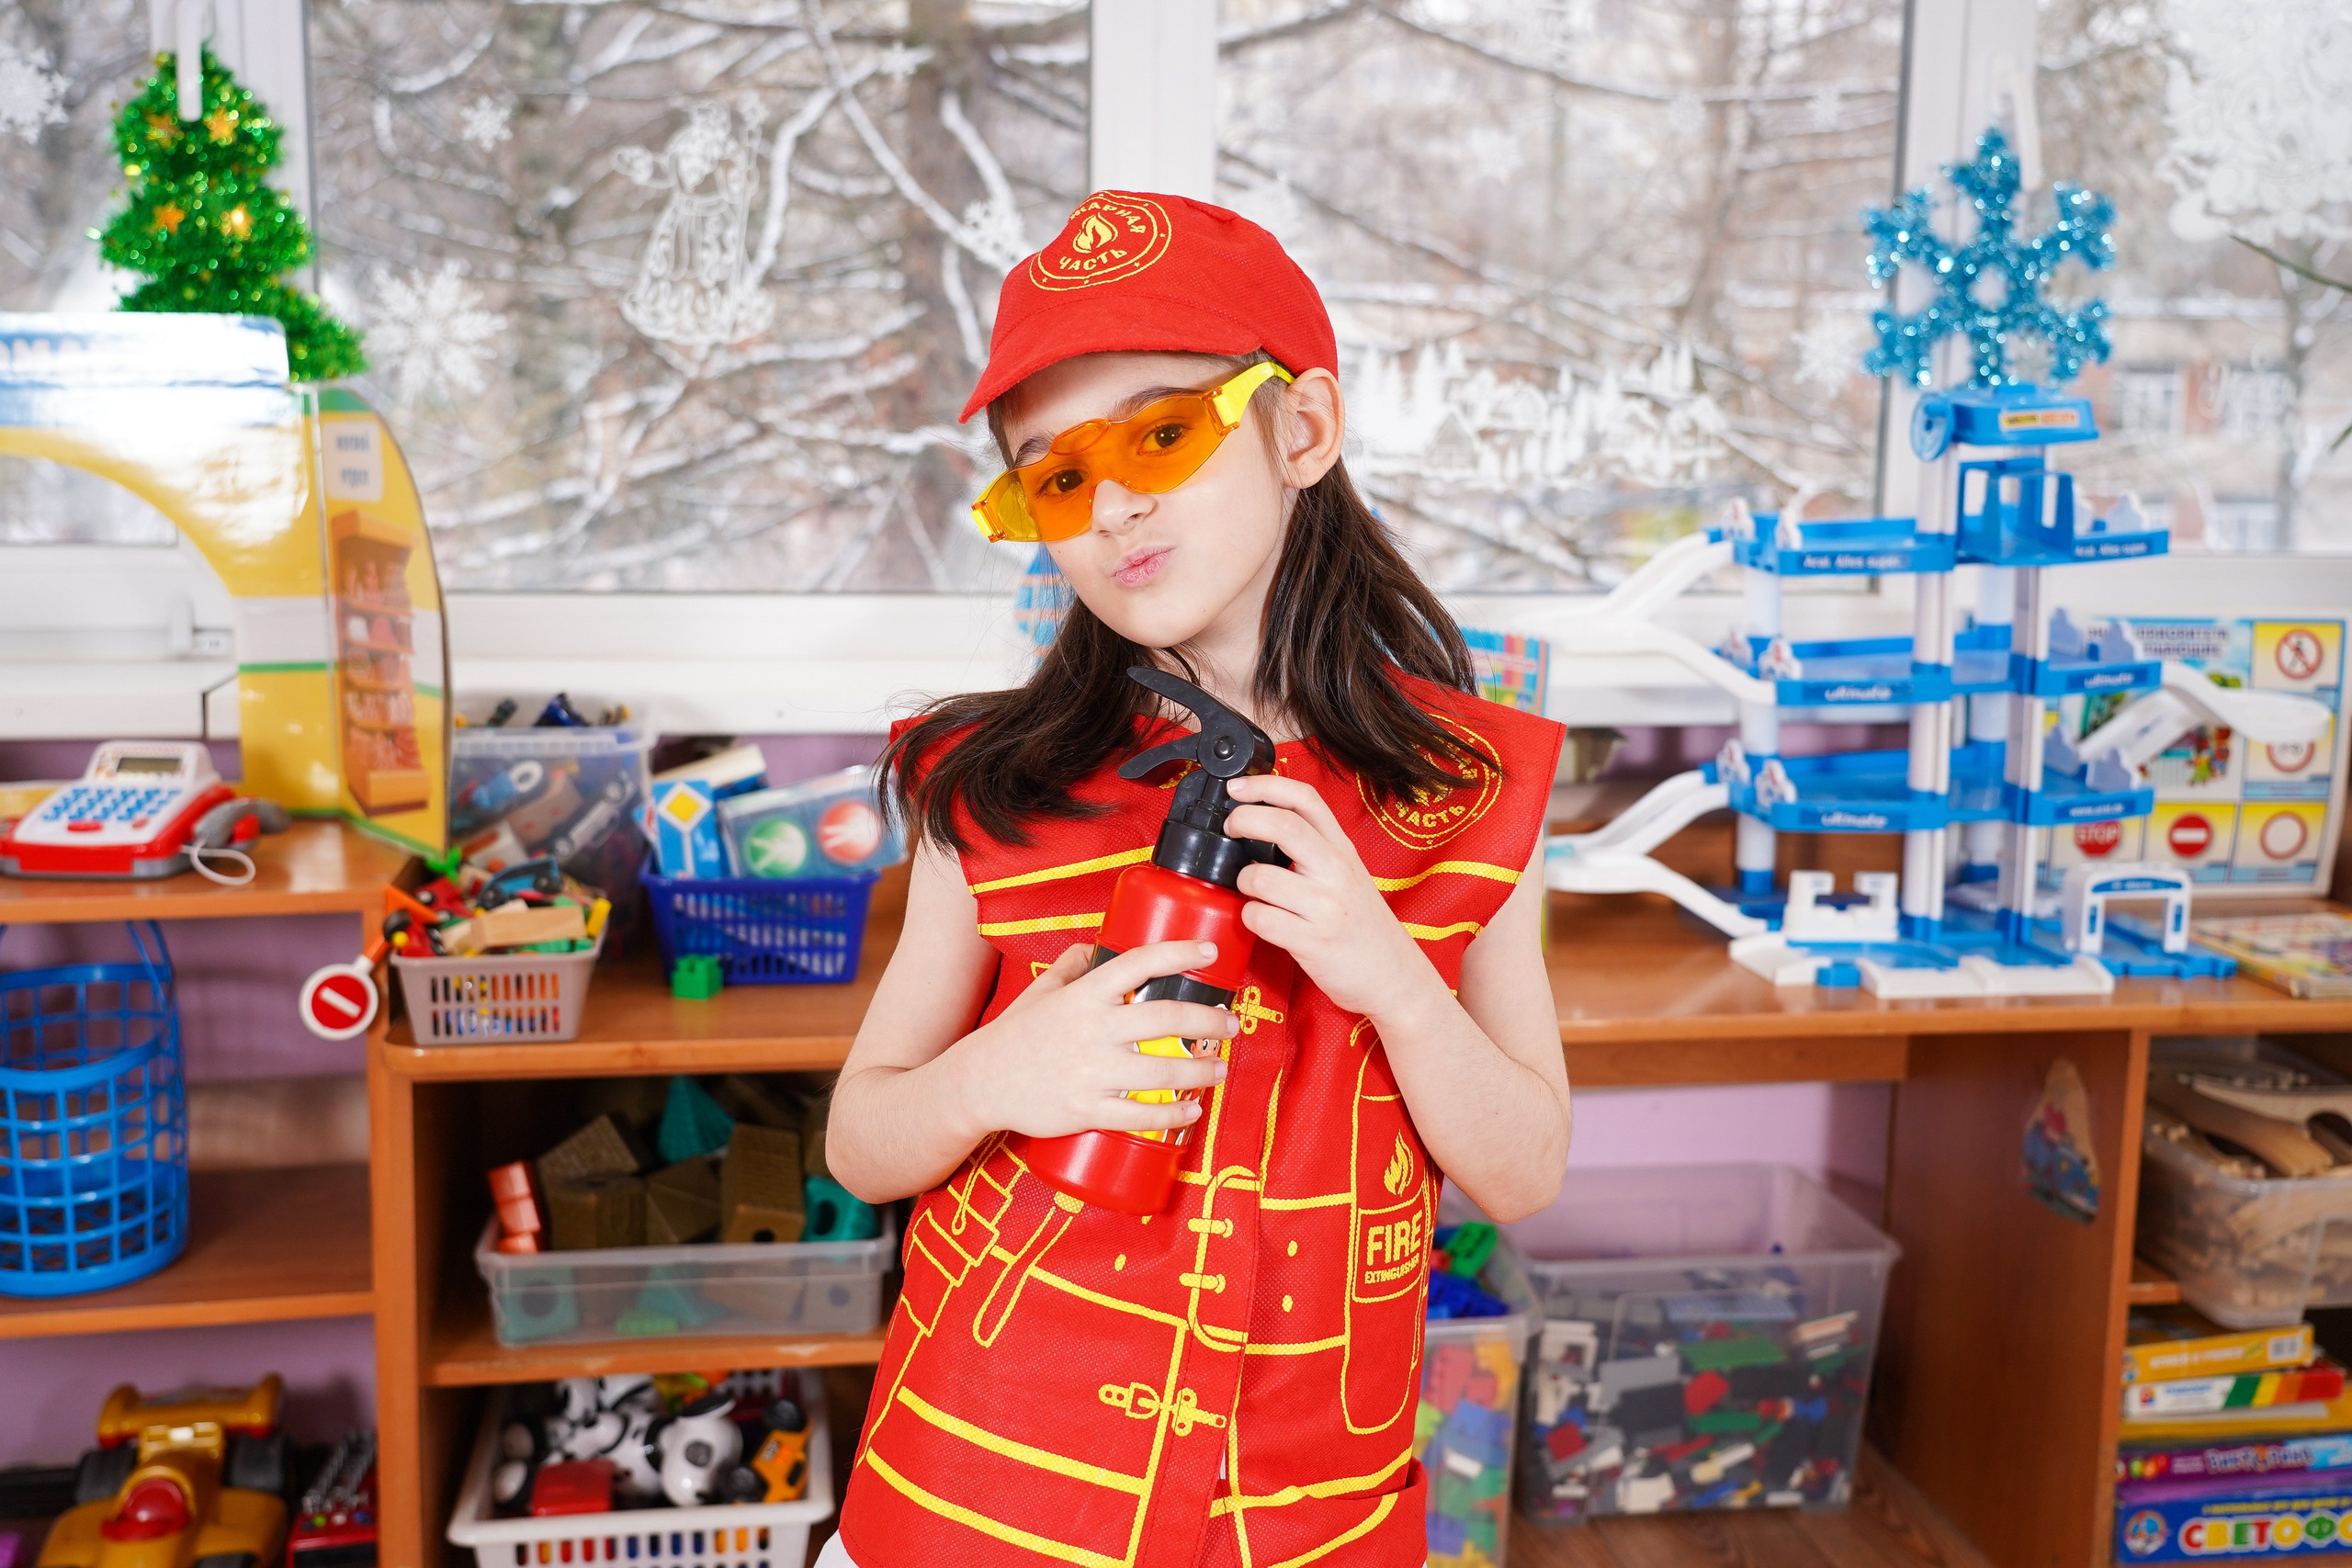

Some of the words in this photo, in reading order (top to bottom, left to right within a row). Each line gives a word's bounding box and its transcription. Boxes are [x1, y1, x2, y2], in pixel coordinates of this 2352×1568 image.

[1058, 248, 1128, 271] ЧАСТЬ
[1395, 800, 1466, 829] ЧАСТЬ
[1366, 1209, 1423, 1267] FIRE
[1364, 1252, 1420, 1284] EXTINGUISHER
